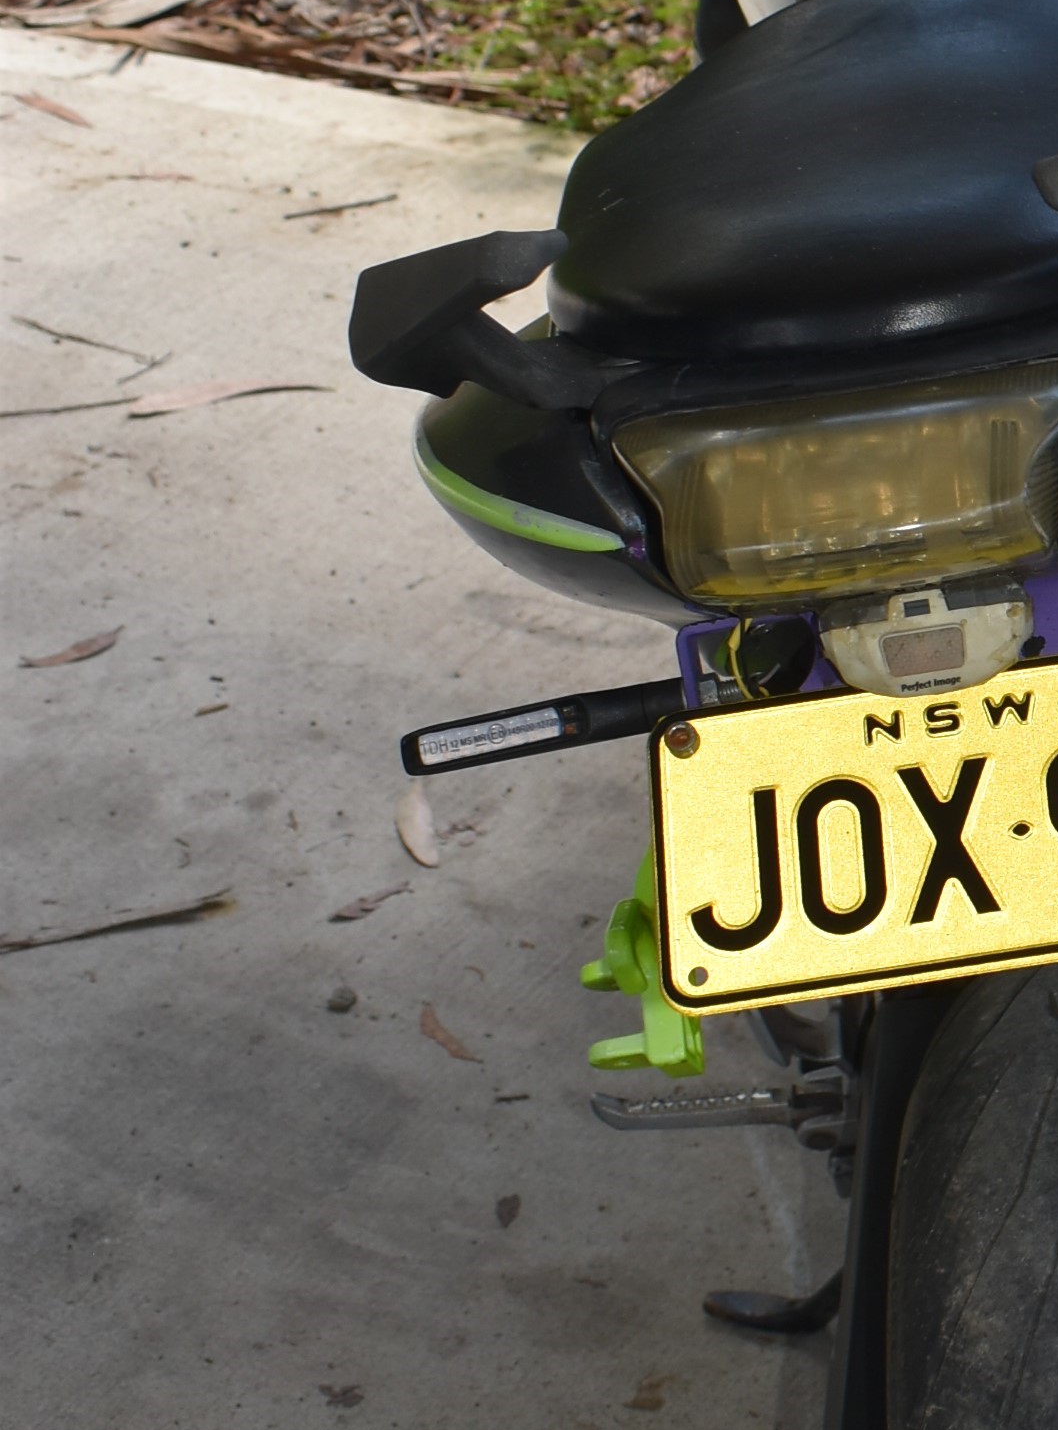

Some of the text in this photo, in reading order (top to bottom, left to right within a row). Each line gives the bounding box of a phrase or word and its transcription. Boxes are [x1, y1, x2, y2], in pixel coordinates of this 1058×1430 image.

[901, 676, 961, 692] Perfect Image
[864, 690, 1036, 746] NSW
